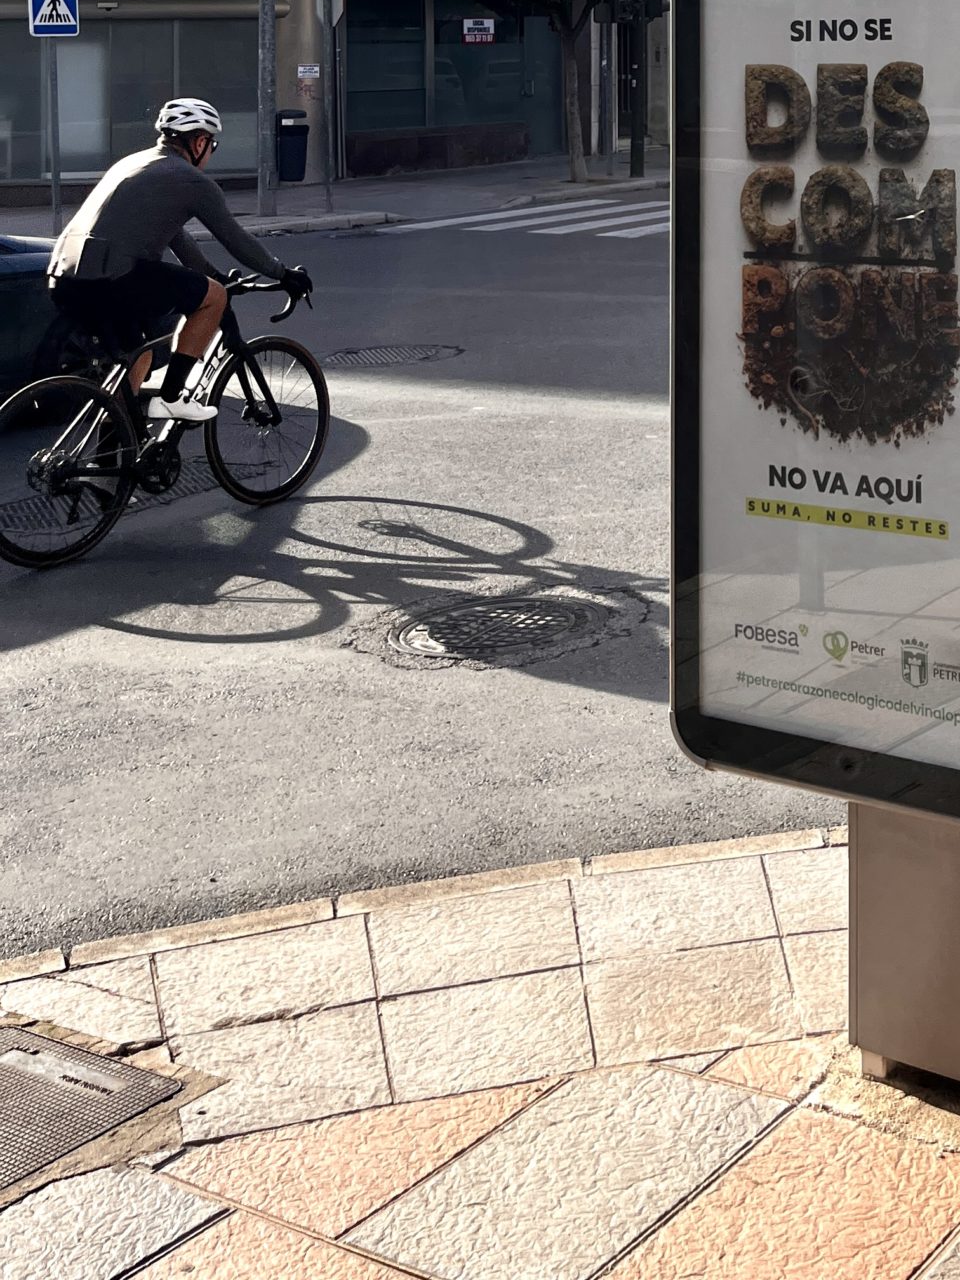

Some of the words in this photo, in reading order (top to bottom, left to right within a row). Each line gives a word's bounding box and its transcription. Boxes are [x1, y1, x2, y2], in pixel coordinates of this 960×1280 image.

[790, 19, 812, 42] SI
[819, 18, 858, 42] NO
[864, 18, 892, 41] SE
[745, 61, 930, 163] DES
[740, 163, 958, 260] COM
[742, 264, 960, 346] PONE
[192, 342, 228, 401] REK
[768, 464, 807, 490] NO
[812, 469, 849, 496] VA
[854, 474, 923, 506] AQUÍ
[748, 500, 811, 521] SUMA,
[826, 510, 852, 524] NO
[868, 515, 946, 536] RESTES
[850, 640, 885, 658] Petrer
